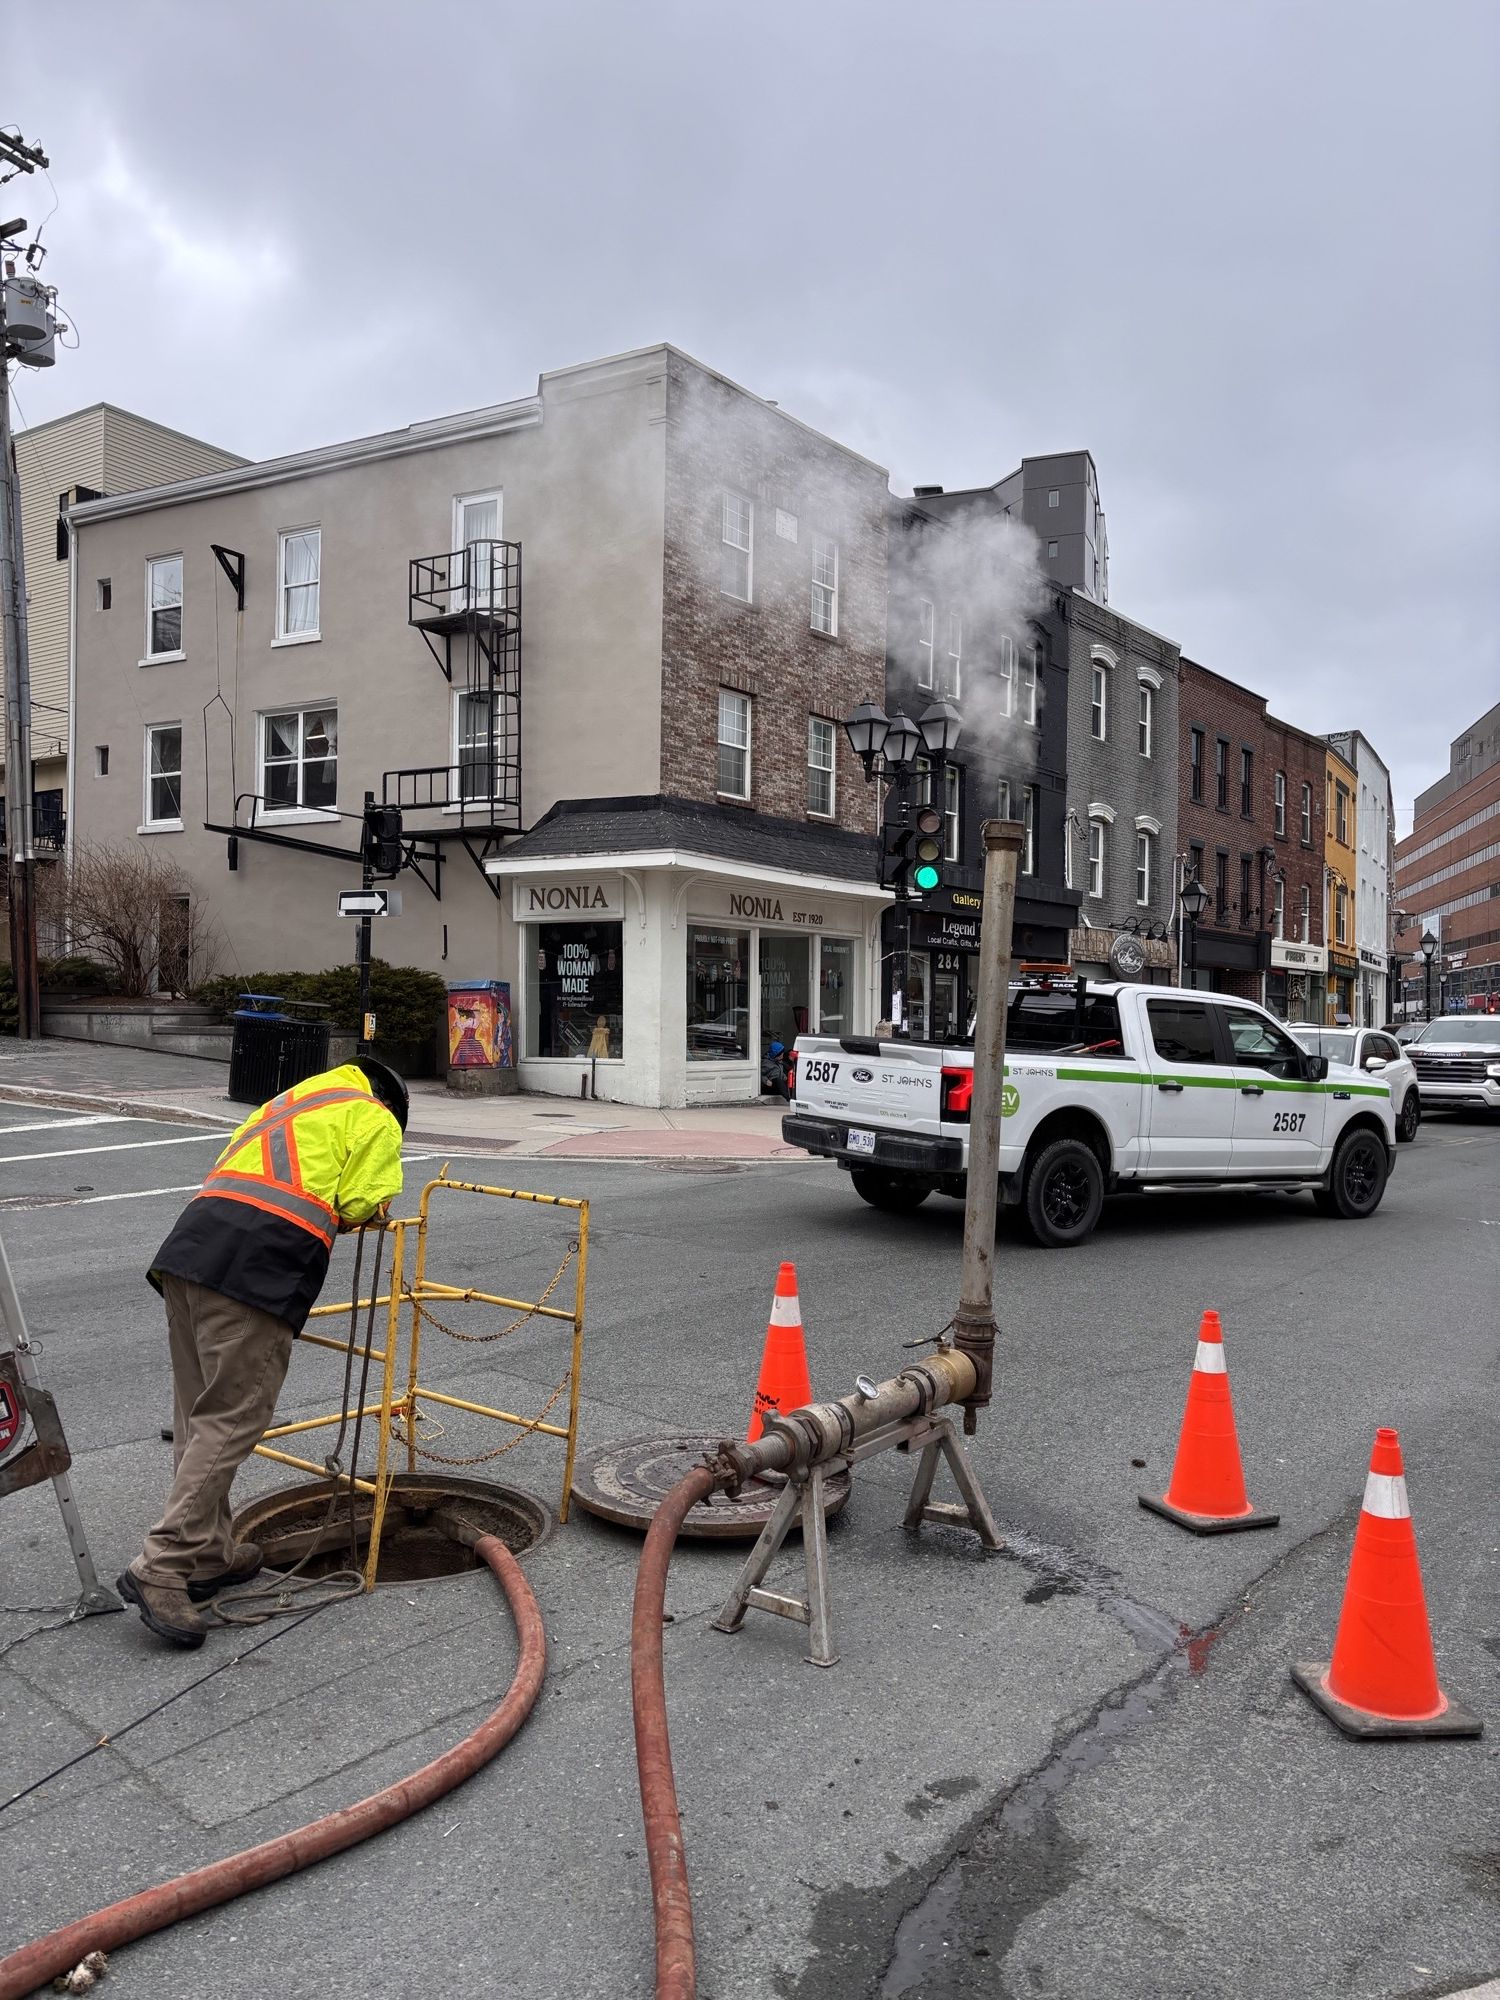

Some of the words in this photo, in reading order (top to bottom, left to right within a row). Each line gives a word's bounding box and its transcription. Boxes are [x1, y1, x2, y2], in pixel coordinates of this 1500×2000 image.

[529, 885, 609, 911] NONIA
[953, 893, 981, 909] Gallery
[730, 894, 784, 921] NONIA
[793, 912, 806, 923] EST
[808, 914, 823, 925] 1920
[942, 917, 976, 938] Legend
[928, 936, 941, 944] Local
[562, 943, 590, 959] 100%
[557, 960, 595, 976] WOMAN
[937, 953, 959, 970] 284
[561, 978, 590, 993] MADE
[805, 1060, 840, 1084] 2587
[1025, 1068, 1054, 1077] JOHN'S
[881, 1074, 895, 1084] ST.
[897, 1076, 932, 1089] JOHN'S
[1273, 1112, 1306, 1132] 2587
[863, 1136, 874, 1147] 530
